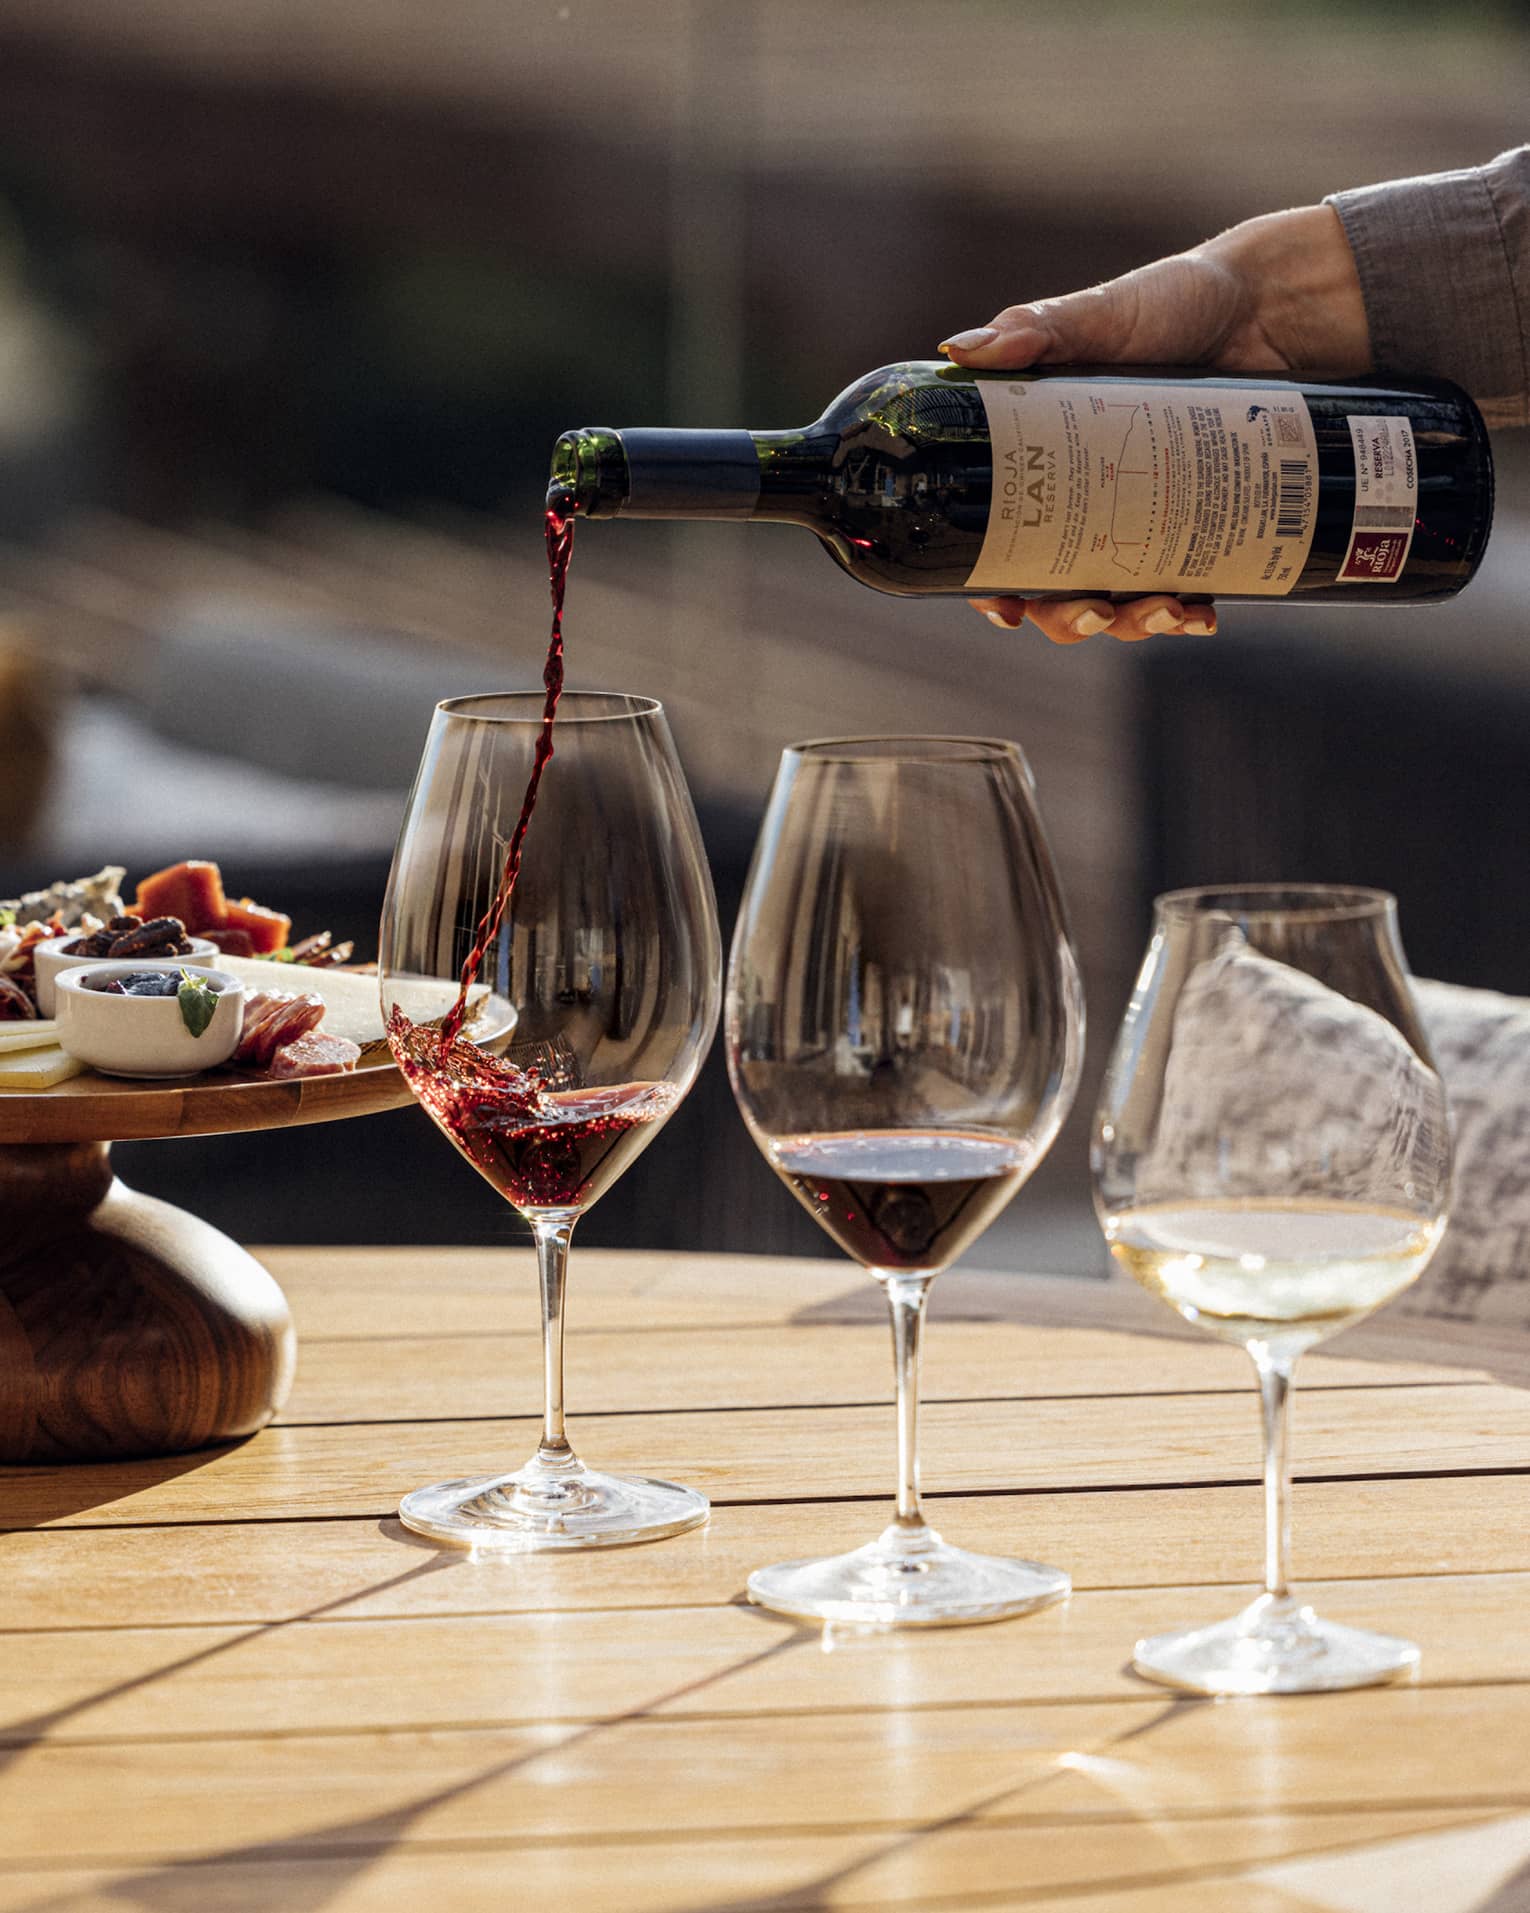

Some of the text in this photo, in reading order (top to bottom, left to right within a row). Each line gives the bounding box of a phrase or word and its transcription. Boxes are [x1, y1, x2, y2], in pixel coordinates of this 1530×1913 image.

[1001, 450, 1017, 520] RIOJA
[1023, 446, 1044, 527] LAN
[1044, 450, 1057, 523] RESERVA
[1361, 478, 1369, 492] UE
[1372, 438, 1384, 479] RESERVA
[1401, 430, 1414, 489] COSECHA 2017
